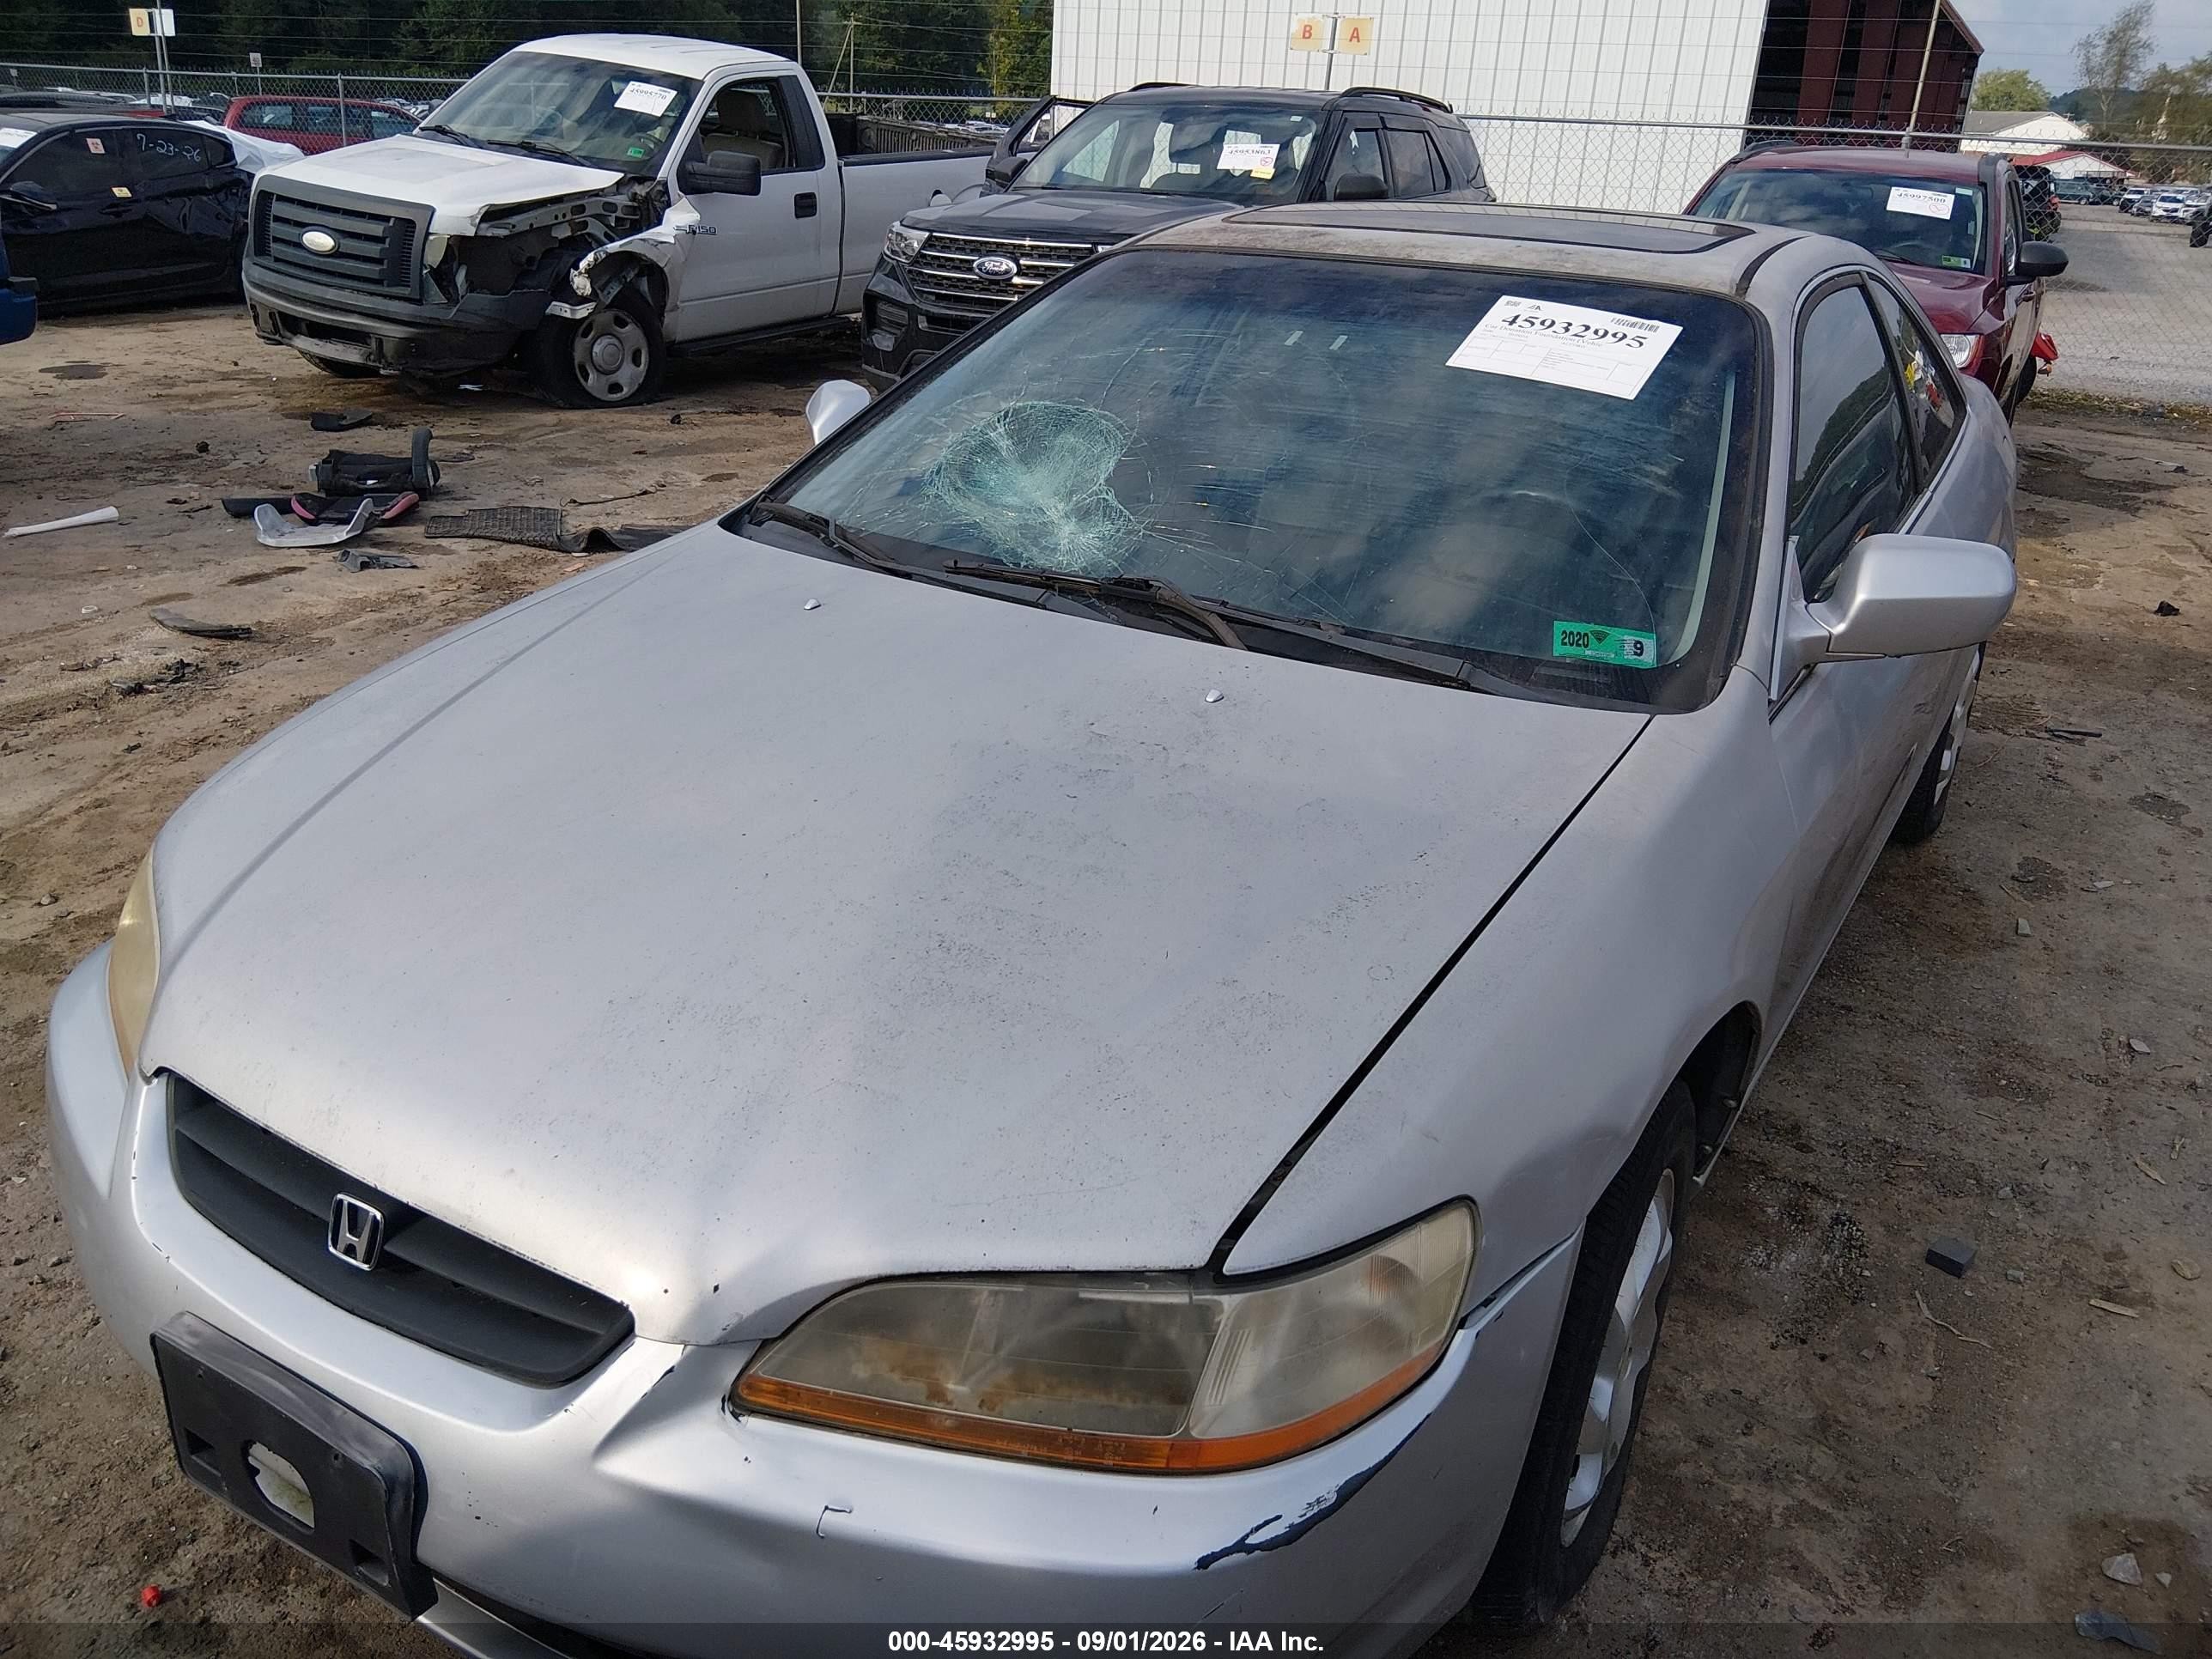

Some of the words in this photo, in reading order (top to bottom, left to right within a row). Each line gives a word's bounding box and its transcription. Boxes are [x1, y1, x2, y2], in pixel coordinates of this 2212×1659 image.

[137, 16, 143, 27] D
[1302, 24, 1313, 40] B
[1348, 27, 1361, 43] A
[1896, 191, 1947, 204] 45997500
[1501, 313, 1648, 349] 45932995
[1560, 629, 1590, 649] 2020
[1632, 640, 1644, 657] 9
